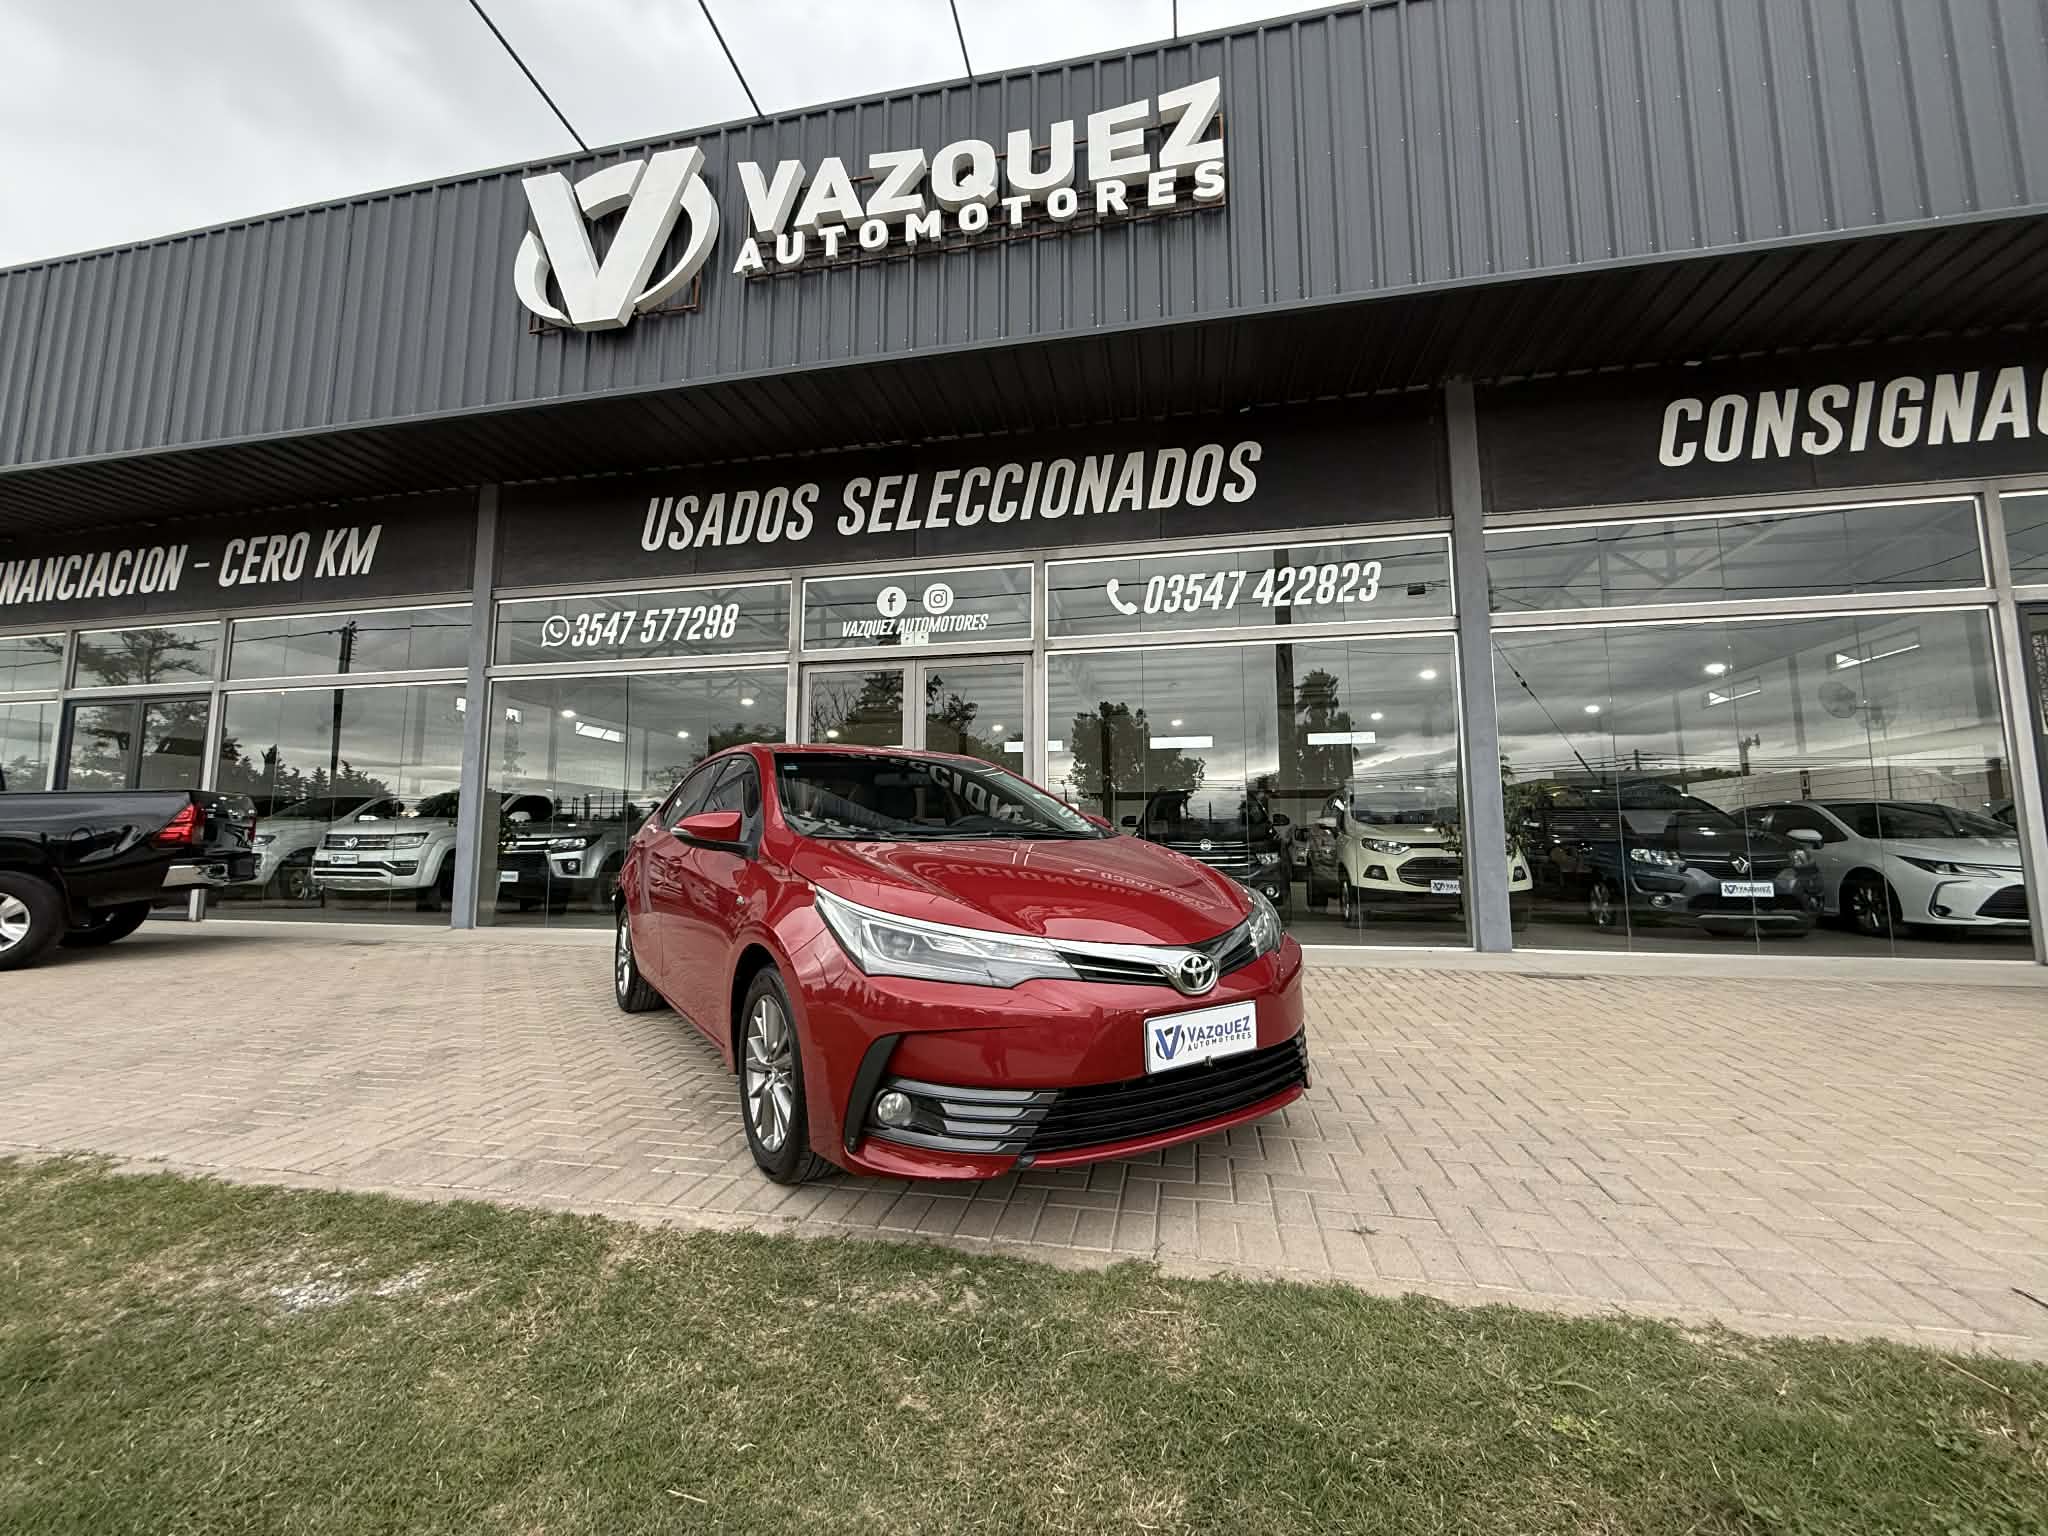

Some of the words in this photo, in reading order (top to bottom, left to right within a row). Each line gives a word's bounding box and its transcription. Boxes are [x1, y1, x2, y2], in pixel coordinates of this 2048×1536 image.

[737, 76, 1224, 240] VAZQUEZ
[732, 161, 1226, 277] AUTOMOTORES
[1658, 366, 2048, 467] CONSIGNA
[641, 483, 820, 552] USADOS
[837, 441, 1262, 537] SELECCIONADOS
[0, 544, 188, 605] NANCIACION
[218, 532, 311, 587] CERO
[314, 524, 382, 578] KM
[1143, 570, 1247, 614] 03547
[1252, 561, 1383, 607] 422823
[571, 610, 637, 647] 3547
[639, 603, 739, 643] 577298
[842, 619, 896, 639] VAZQUEZ
[896, 613, 989, 635] AUTOMOTORES
[1187, 1015, 1251, 1043] VAZQUEZ
[1187, 1032, 1252, 1052] AUTOMOTORES
